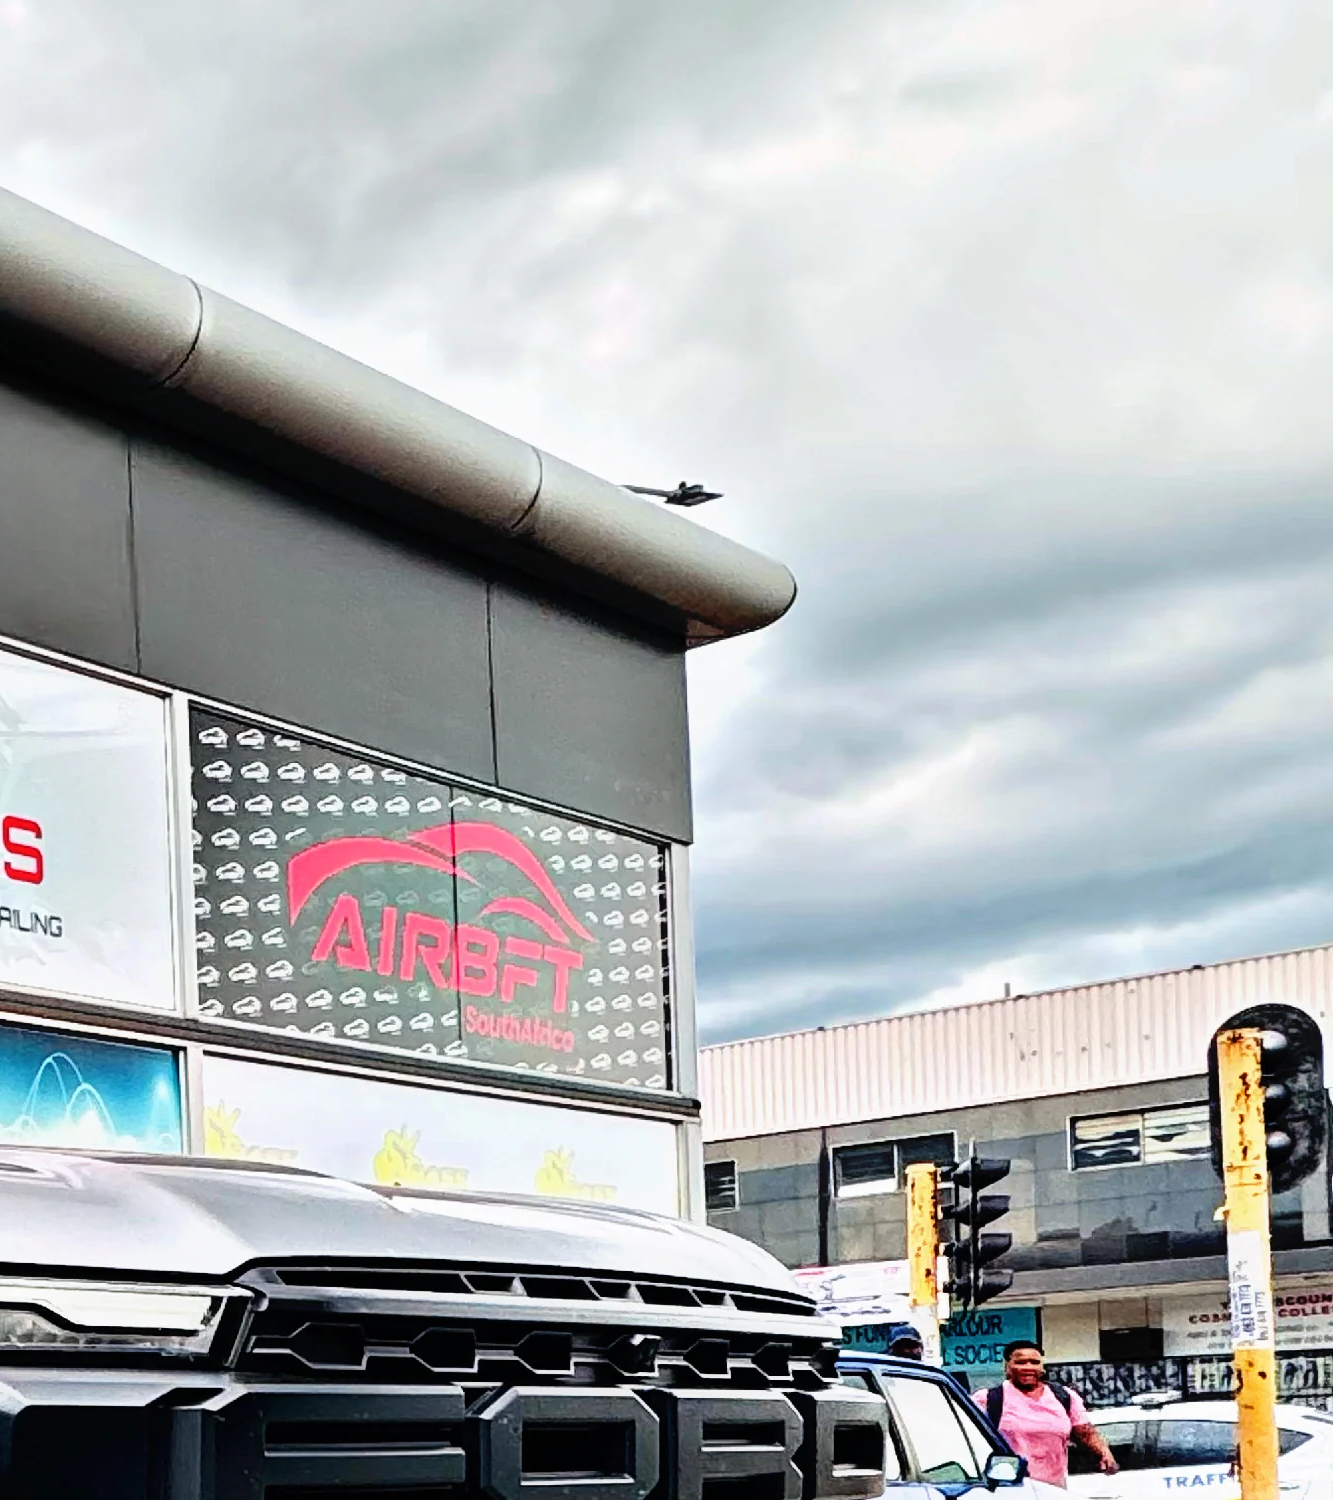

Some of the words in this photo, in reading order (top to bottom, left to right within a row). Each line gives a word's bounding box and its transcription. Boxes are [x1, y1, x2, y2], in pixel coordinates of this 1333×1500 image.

[311, 893, 584, 1014] AIRBFT
[1278, 1305, 1333, 1317] COLLE
[954, 1342, 1008, 1364] SOCIE
[1163, 1473, 1237, 1489] TRAFF
